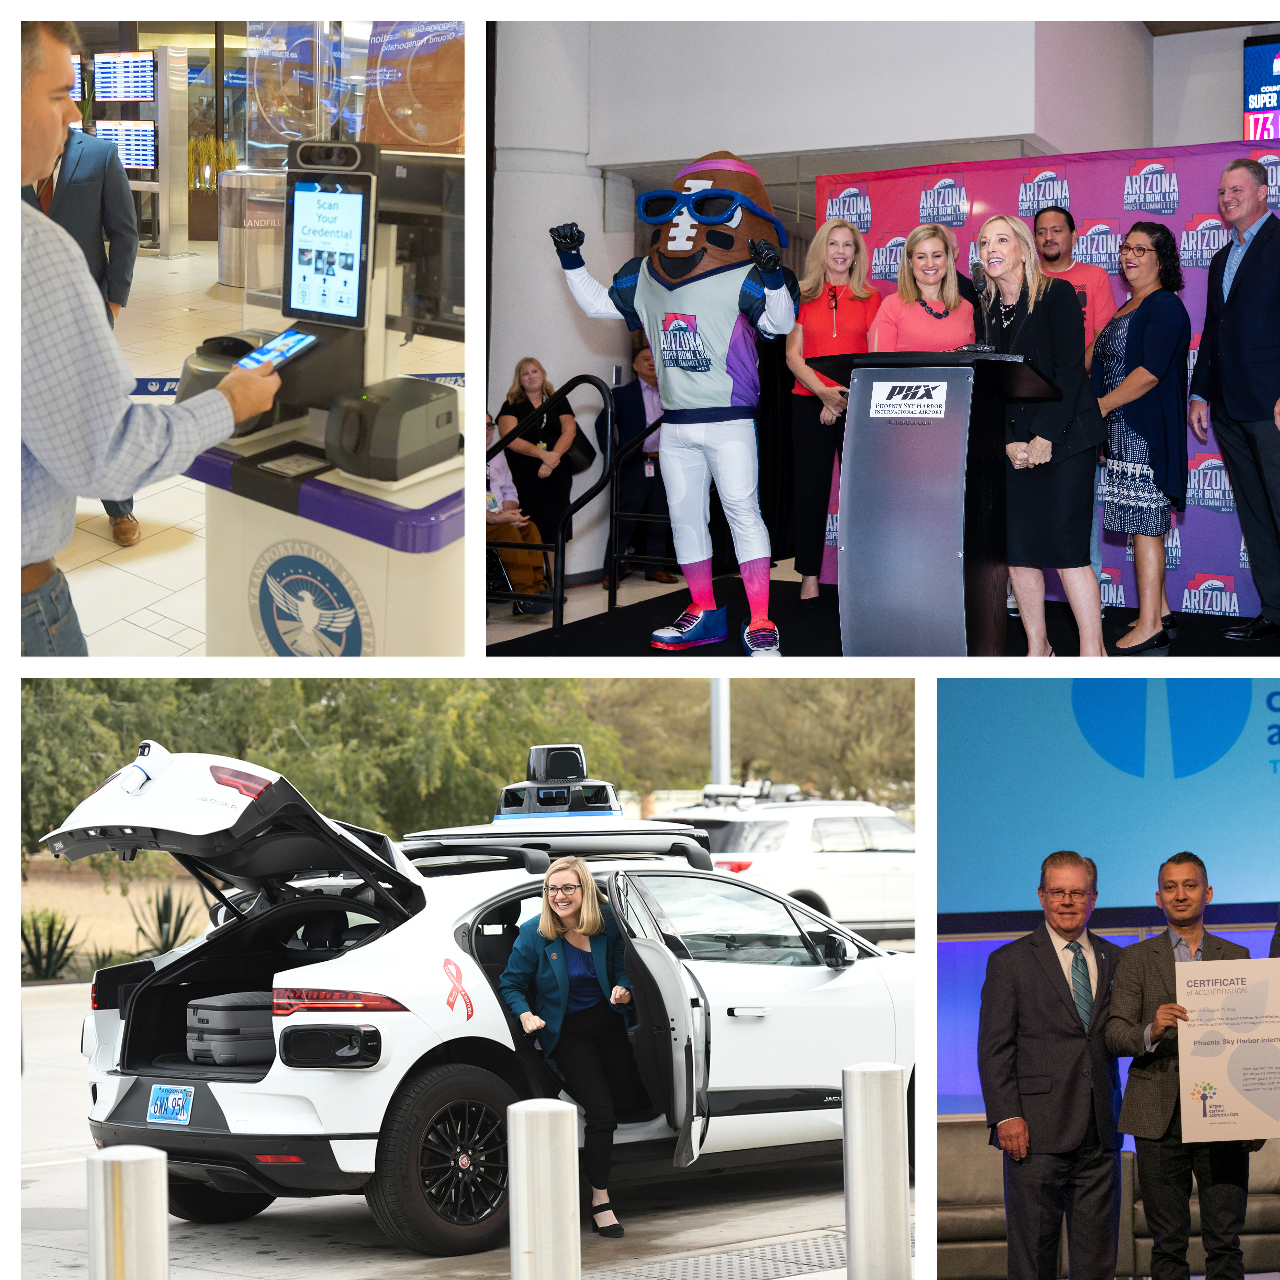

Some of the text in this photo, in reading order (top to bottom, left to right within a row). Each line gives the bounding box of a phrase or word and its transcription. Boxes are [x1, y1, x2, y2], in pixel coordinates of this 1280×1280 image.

[1248, 93, 1277, 109] SUPER
[1248, 112, 1274, 140] 173
[1018, 180, 1070, 202] ARIZONA
[1124, 173, 1179, 195] ARIZONA
[316, 199, 339, 210] Scan
[920, 187, 968, 209] ARIZONA
[1124, 191, 1179, 204] SUPER BOWL LVII
[243, 219, 282, 227] LANDFILL
[316, 214, 338, 224] Your
[302, 226, 352, 239] Credential
[886, 385, 940, 400] PHX
[250, 542, 337, 606] TRANSPORTATION
[1186, 978, 1247, 988] CERTIFICATE
[1194, 1038, 1220, 1046] Phoenix
[1222, 1038, 1234, 1046] Sky
